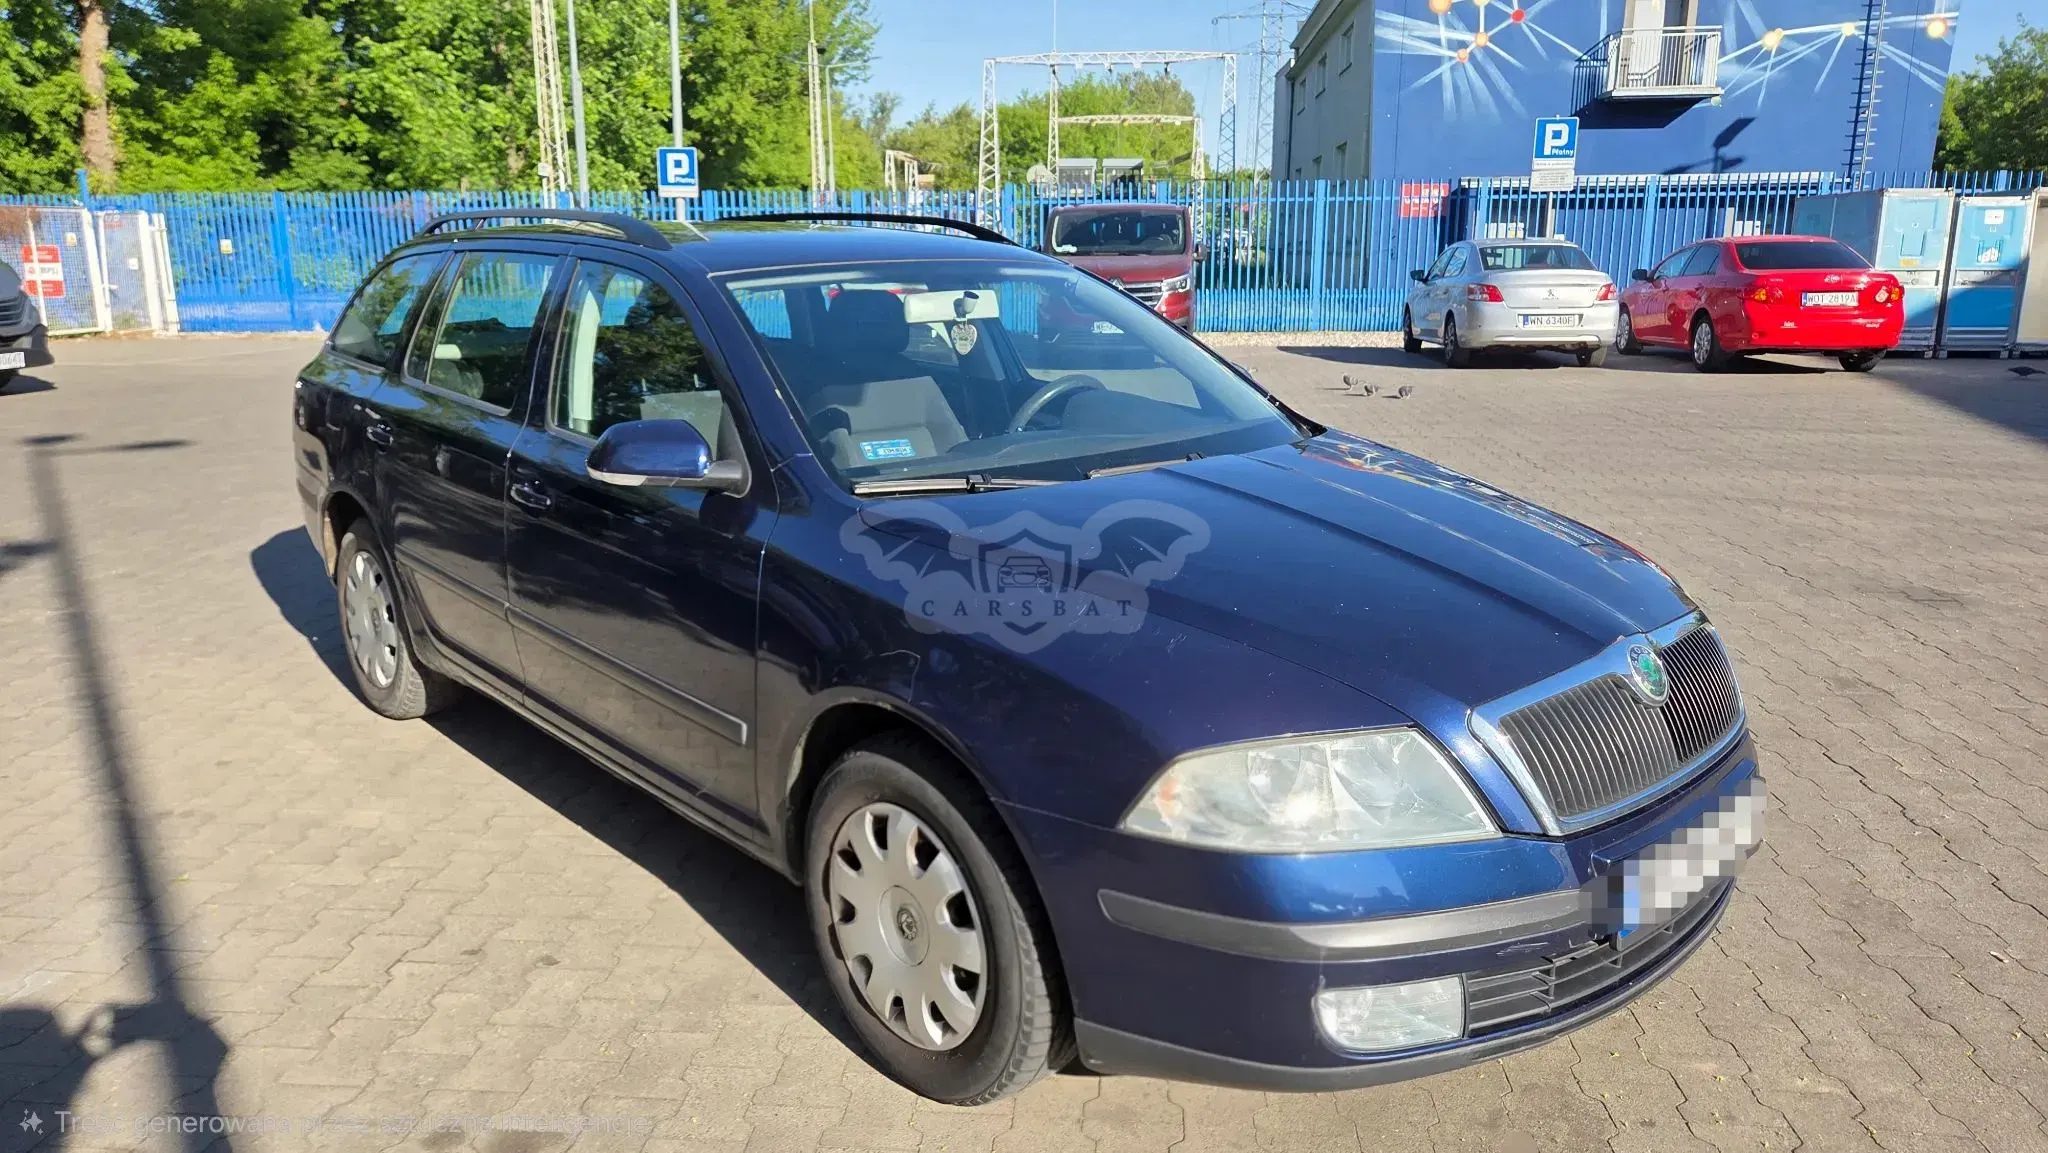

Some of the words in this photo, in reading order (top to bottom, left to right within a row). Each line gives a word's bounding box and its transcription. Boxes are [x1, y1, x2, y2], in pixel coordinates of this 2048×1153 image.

[1544, 123, 1569, 155] P
[666, 153, 690, 183] P
[1807, 294, 1824, 304] WOT
[1530, 316, 1543, 325] WN
